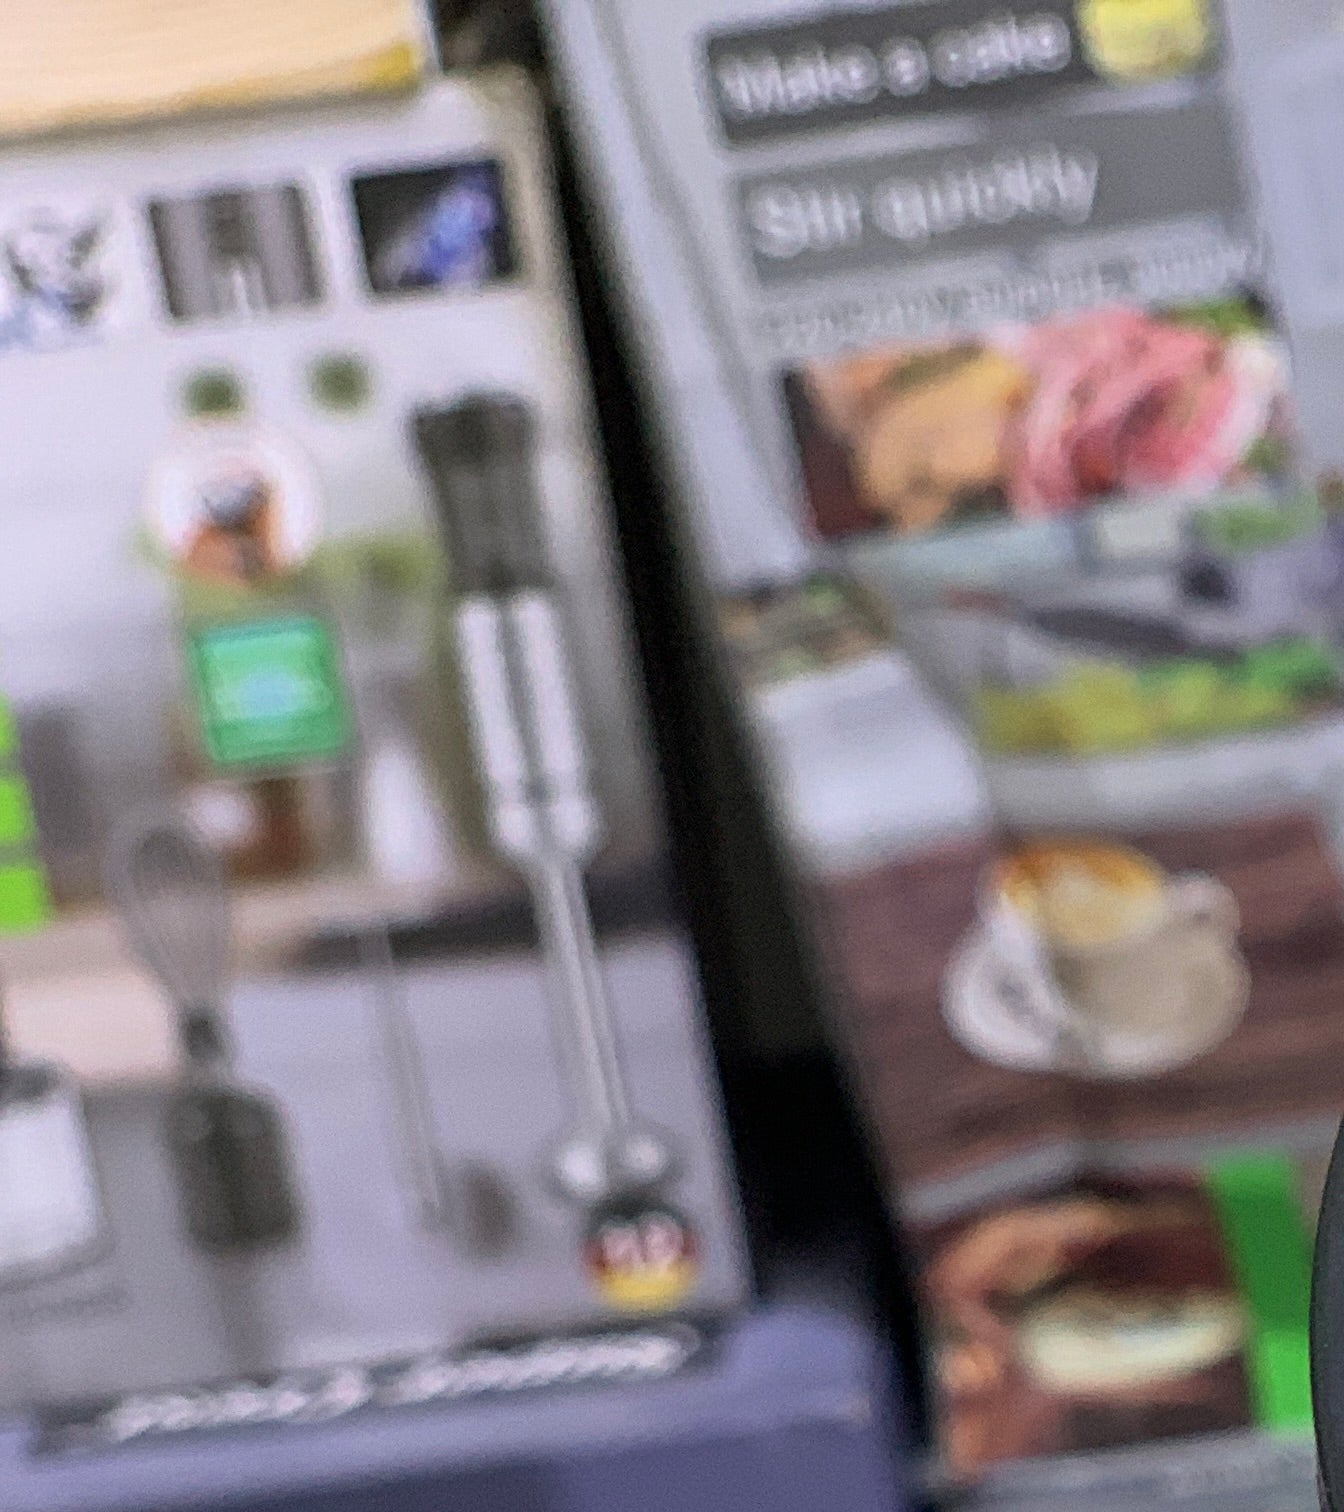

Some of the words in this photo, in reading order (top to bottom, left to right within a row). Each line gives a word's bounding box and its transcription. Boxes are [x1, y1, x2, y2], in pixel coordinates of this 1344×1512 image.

[716, 48, 878, 120] Make
[880, 38, 930, 98] a
[930, 12, 1072, 90] cake
[750, 183, 864, 260] Stir
[872, 143, 1097, 246] quickly
